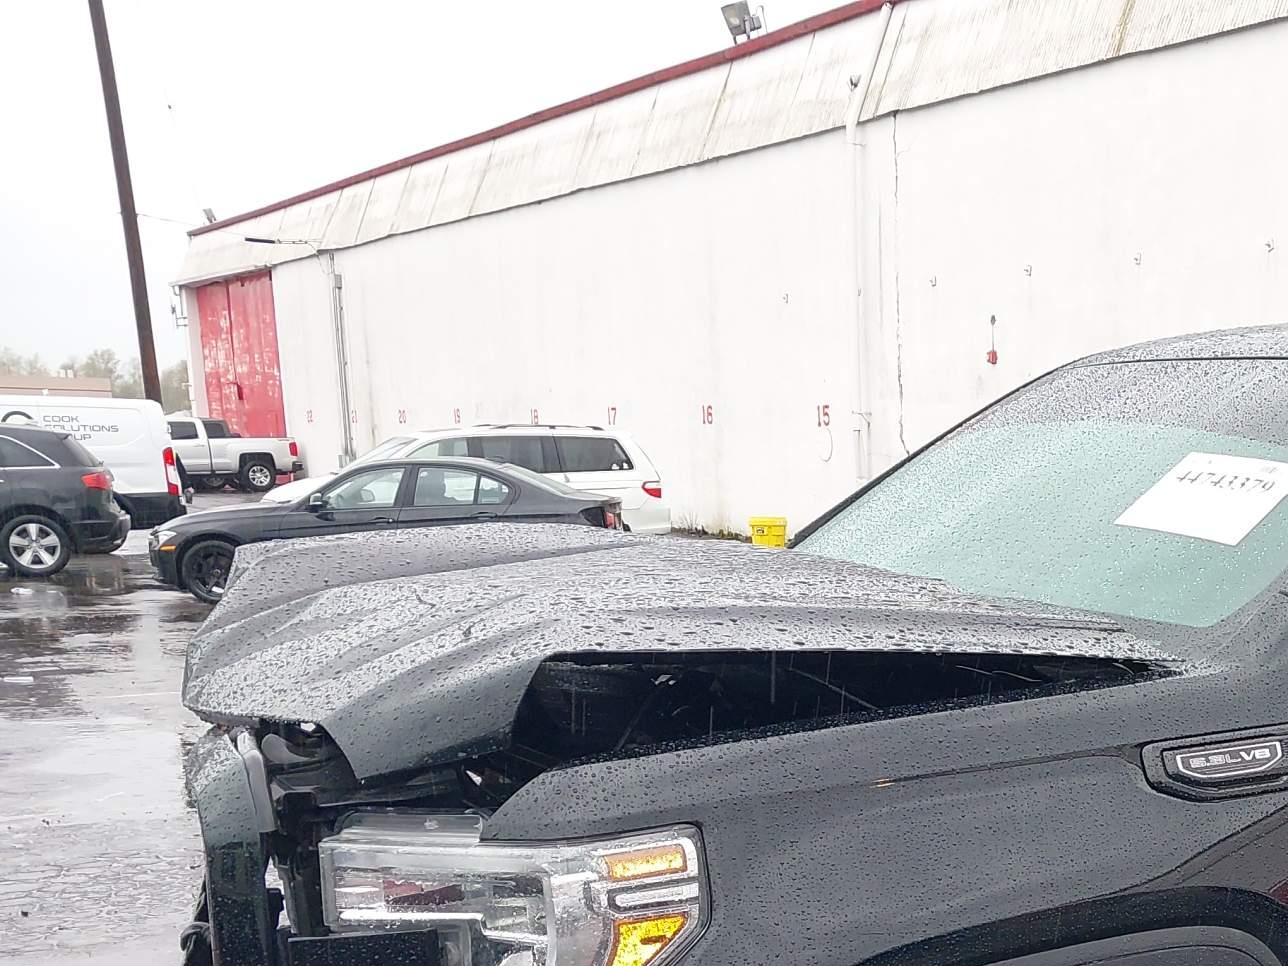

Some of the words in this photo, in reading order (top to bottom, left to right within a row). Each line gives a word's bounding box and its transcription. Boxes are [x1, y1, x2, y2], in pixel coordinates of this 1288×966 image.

[42, 415, 80, 423] COOK
[398, 409, 407, 424] 20
[453, 408, 461, 424] 19
[530, 408, 539, 425] 18
[607, 407, 617, 425] 17
[701, 405, 714, 425] 16
[816, 405, 831, 426] 15
